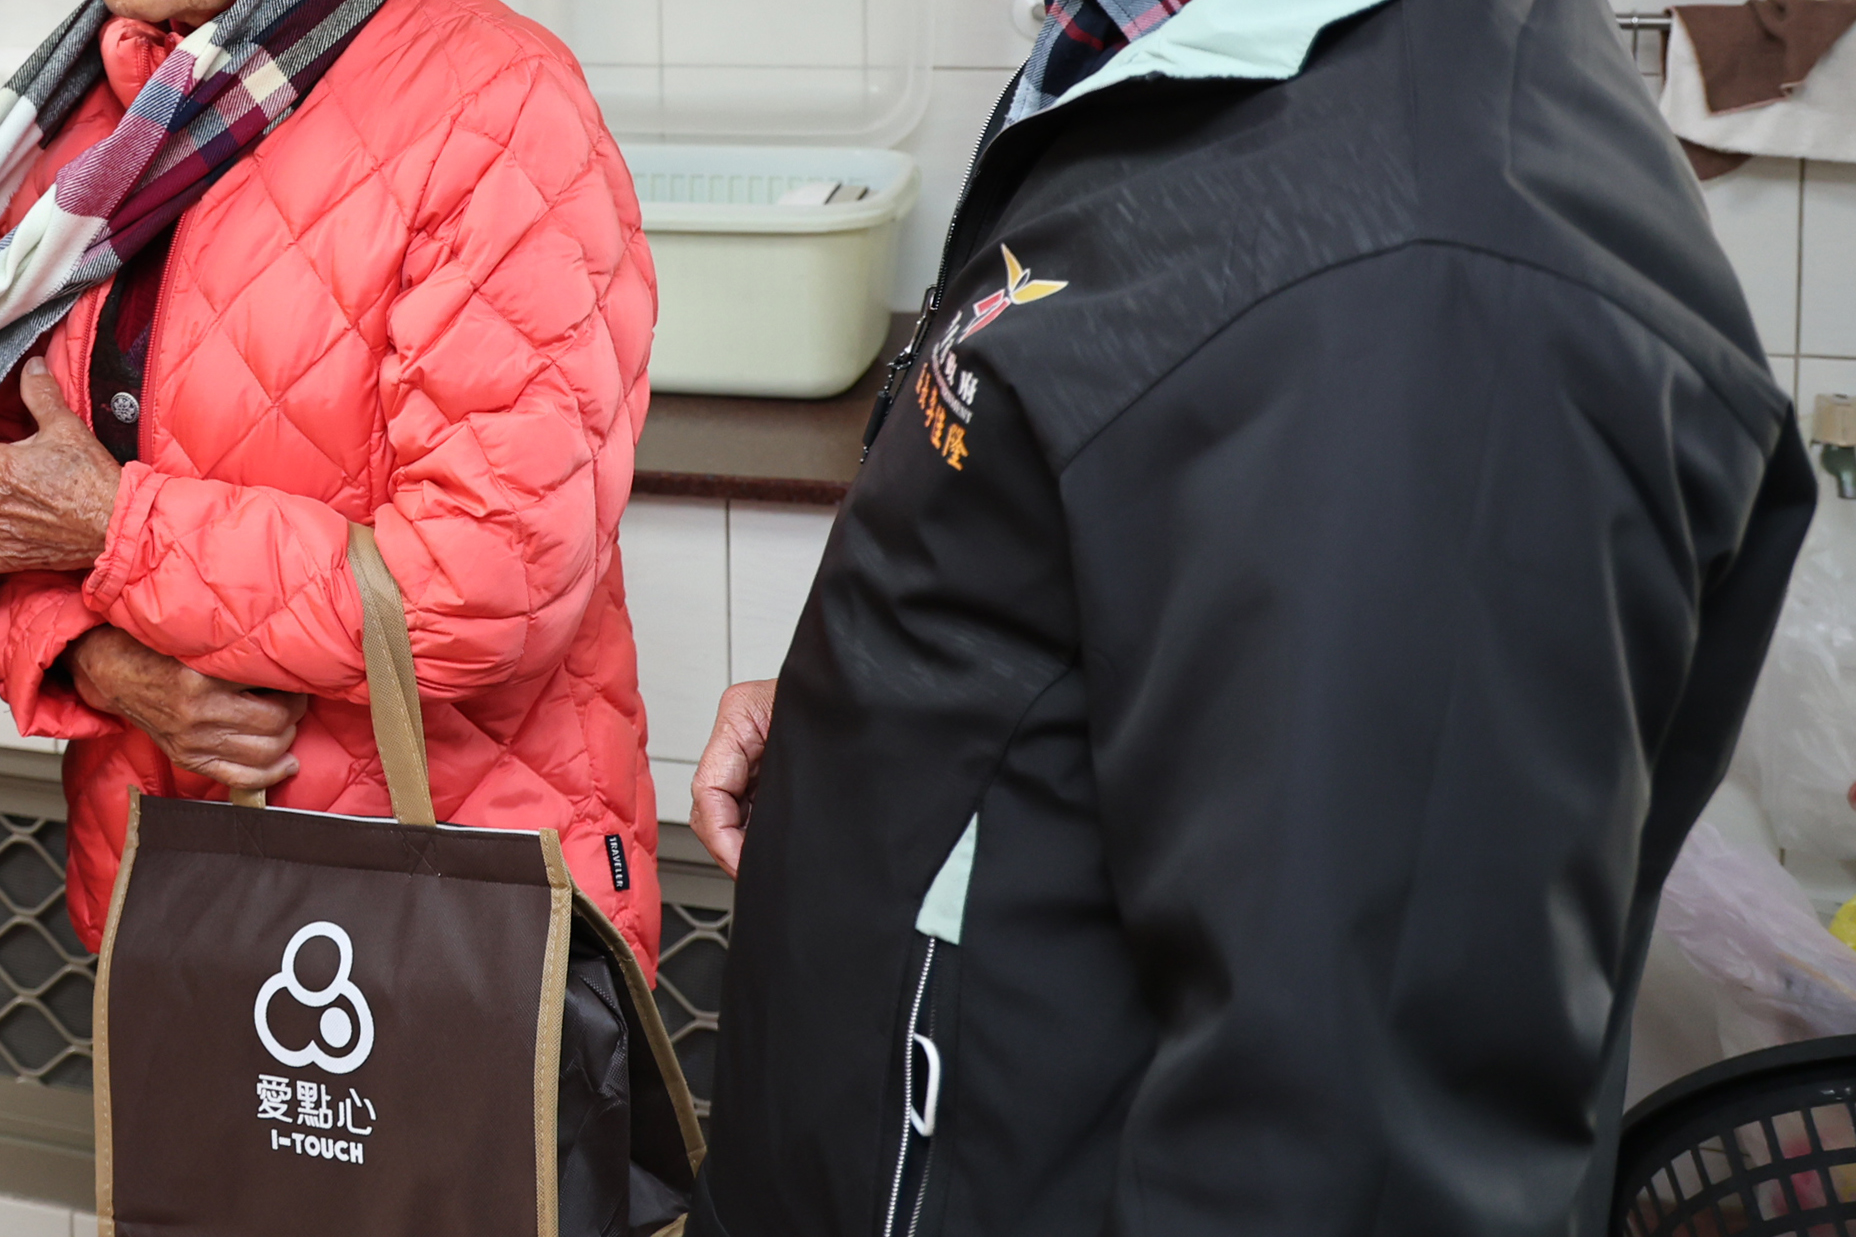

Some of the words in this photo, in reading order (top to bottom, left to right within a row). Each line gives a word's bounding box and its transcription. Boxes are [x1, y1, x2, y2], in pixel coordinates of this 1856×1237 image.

[609, 836, 624, 888] TRAVELER
[257, 1074, 376, 1135] 愛點心
[271, 1128, 364, 1164] I-TOUCH
